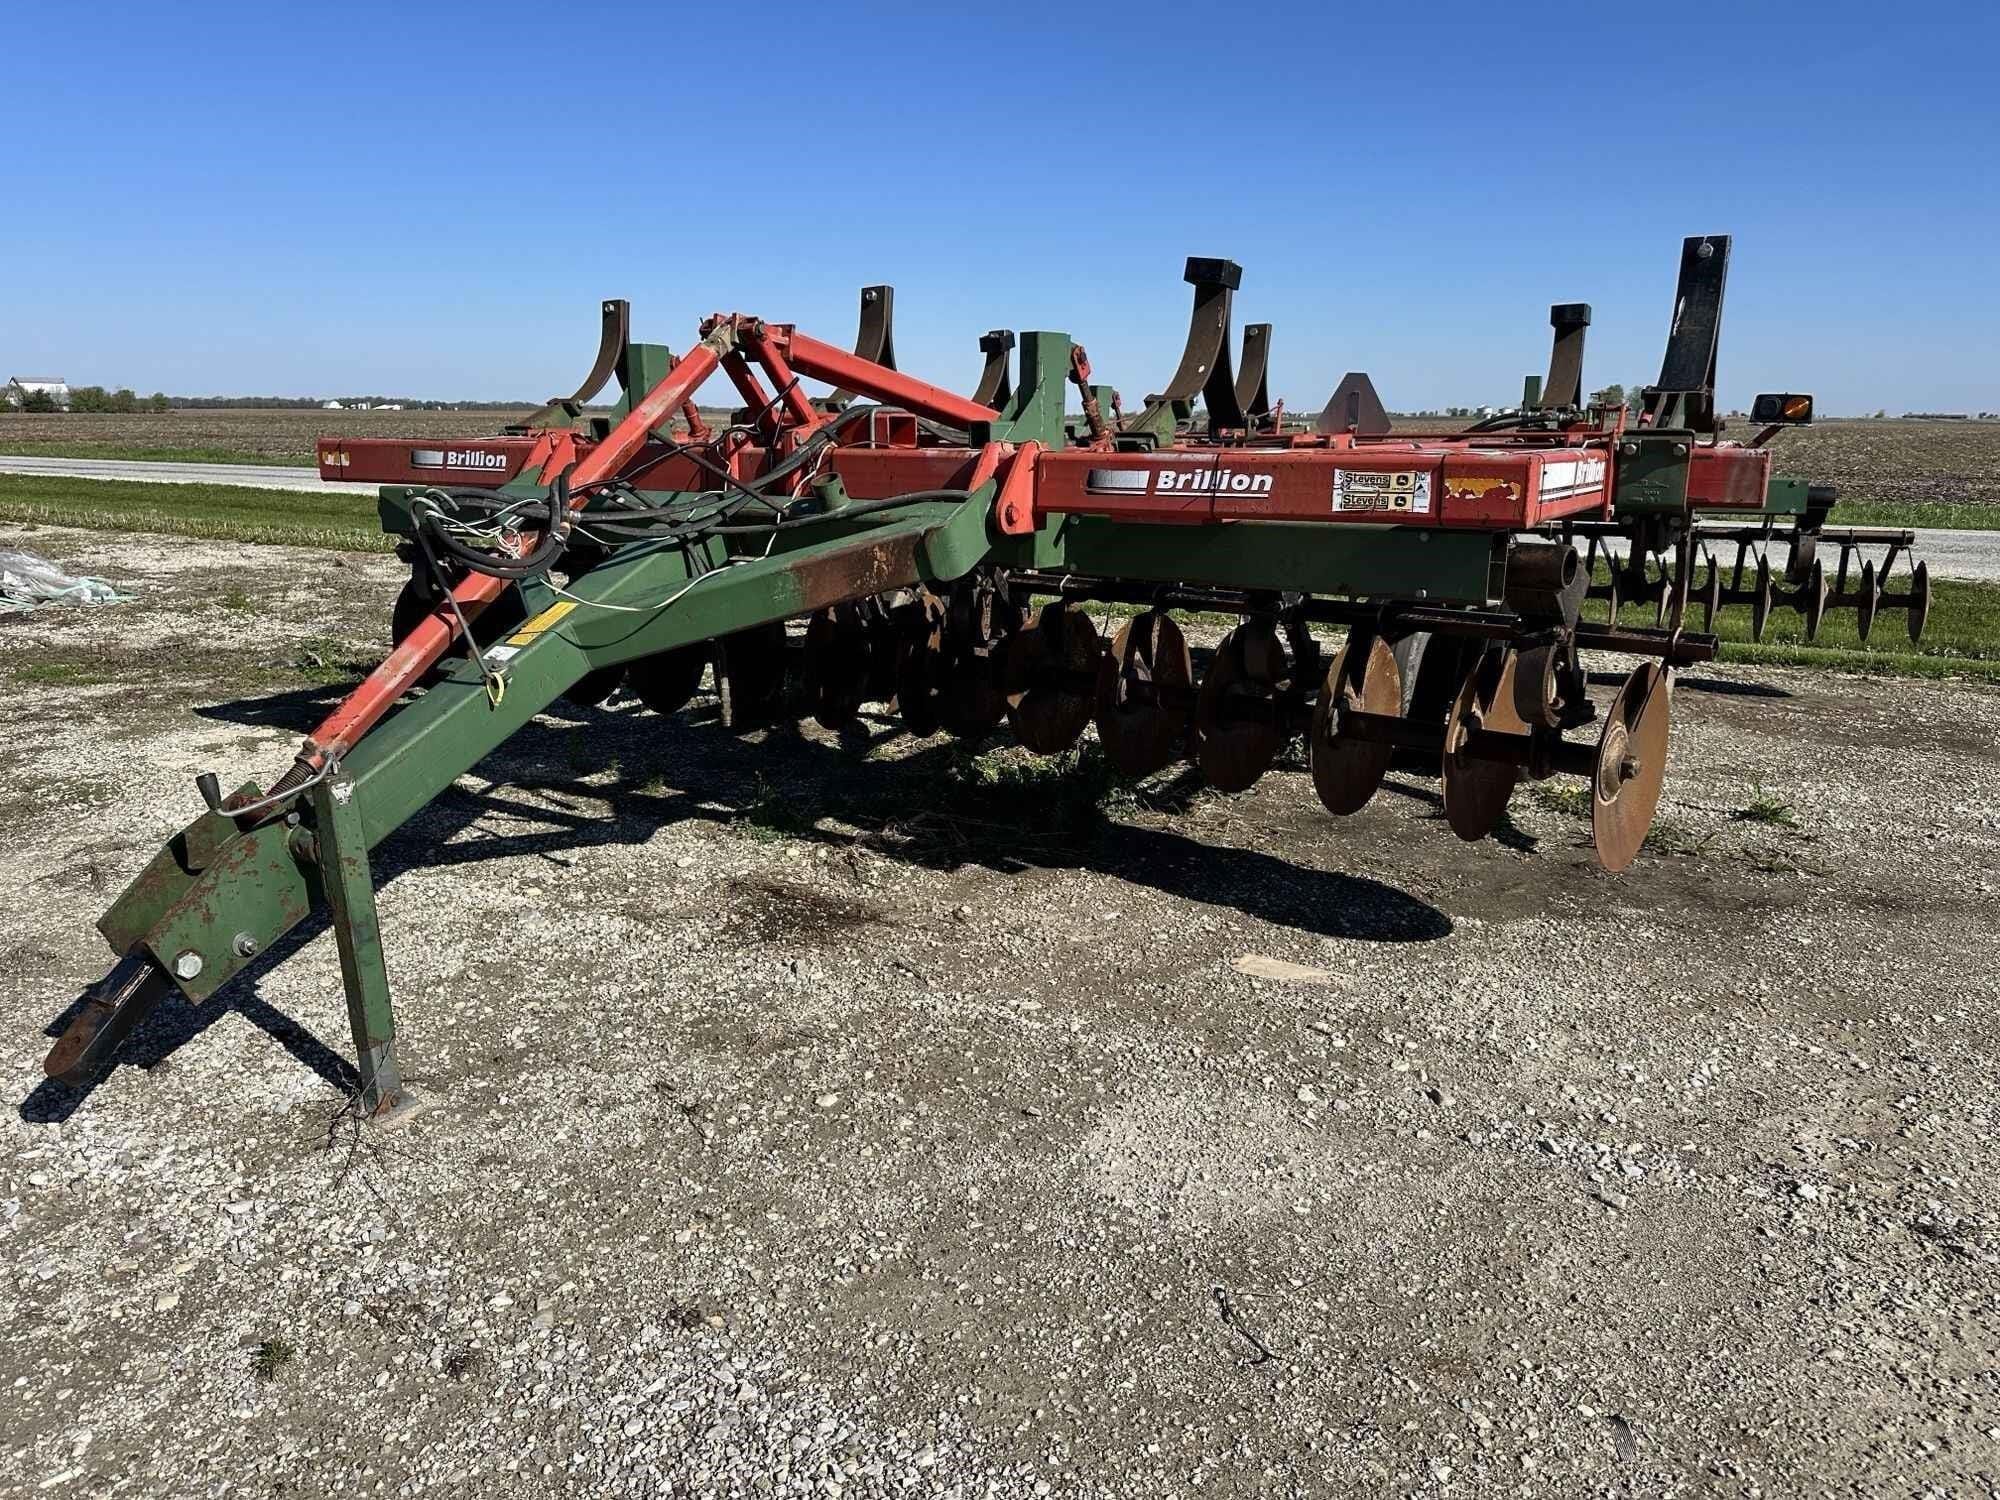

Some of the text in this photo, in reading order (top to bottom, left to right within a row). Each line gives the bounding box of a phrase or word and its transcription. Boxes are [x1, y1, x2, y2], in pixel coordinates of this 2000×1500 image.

[447, 450, 507, 467] Brillion
[1156, 469, 1273, 492] Brillion
[1345, 473, 1388, 483] Stevens
